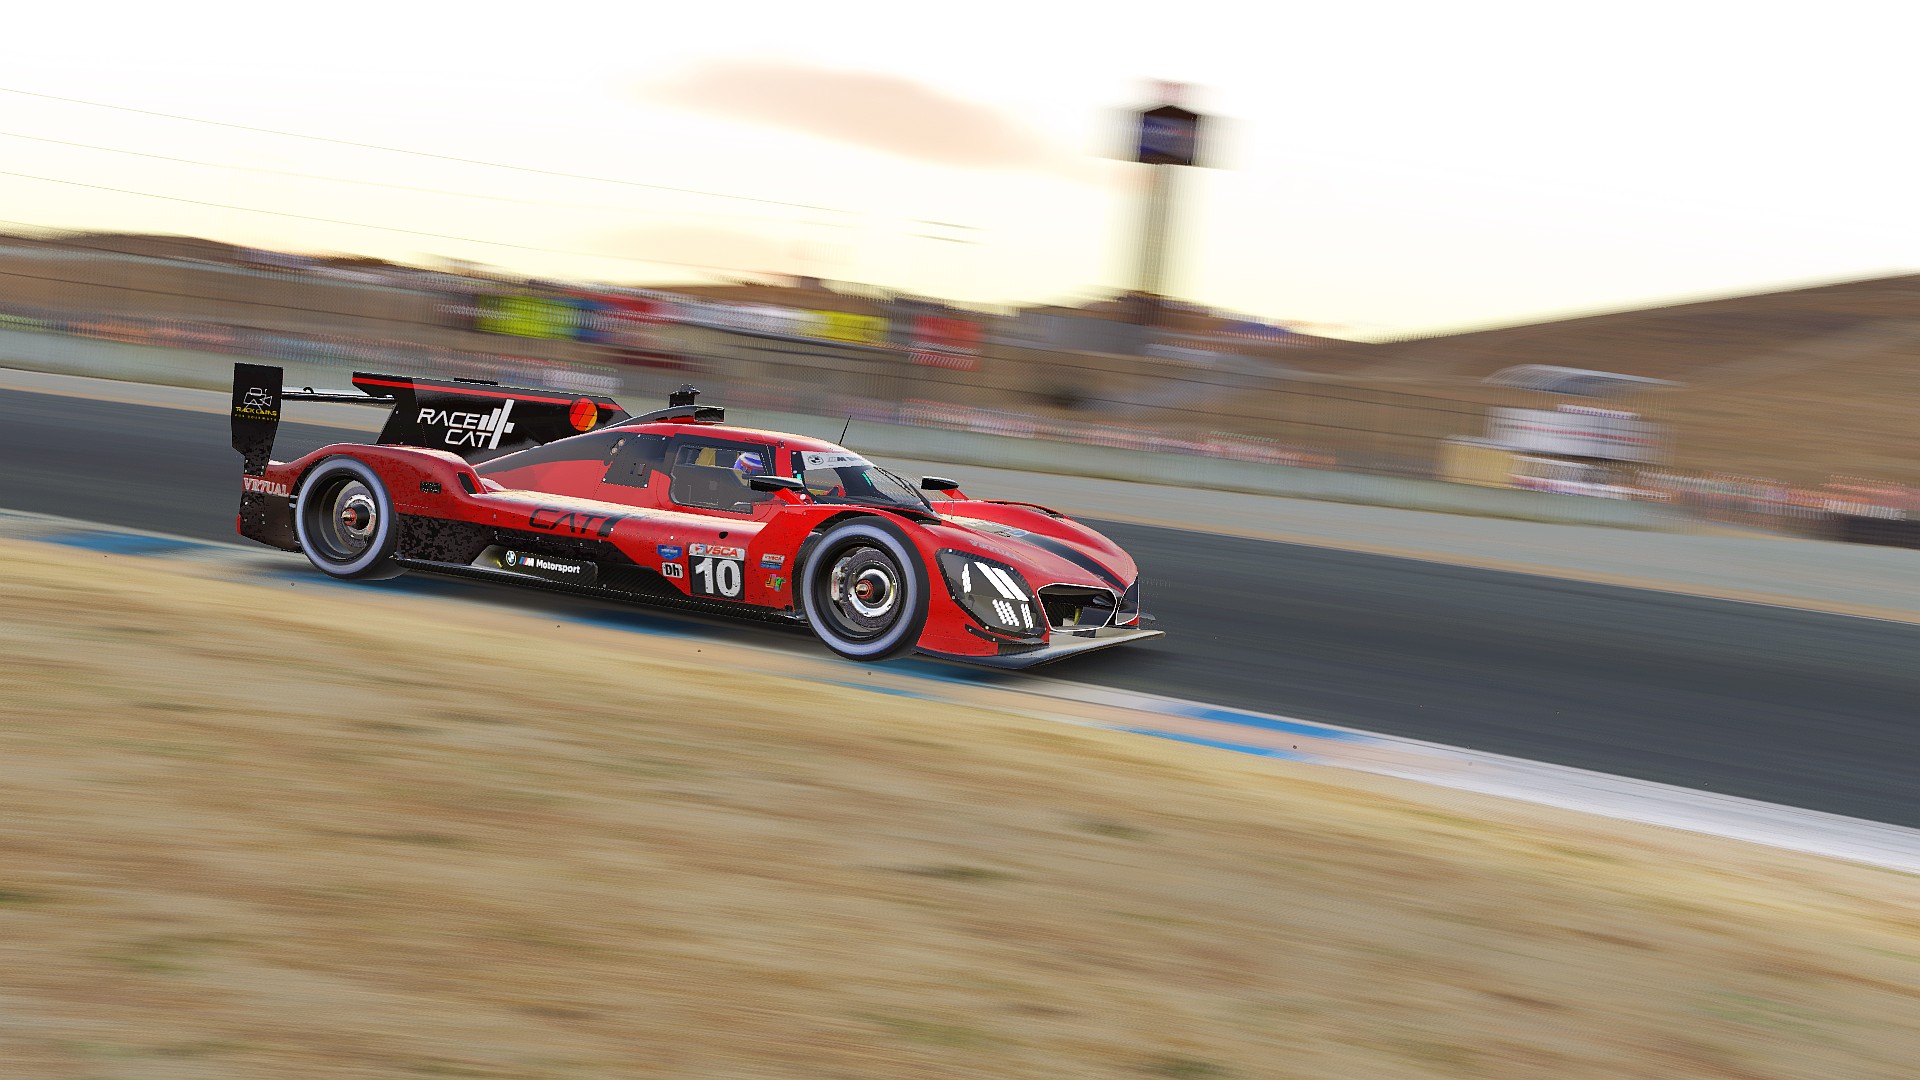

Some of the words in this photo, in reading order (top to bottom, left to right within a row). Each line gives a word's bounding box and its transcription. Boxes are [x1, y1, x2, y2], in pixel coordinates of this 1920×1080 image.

[417, 408, 480, 430] RACE
[444, 428, 492, 448] CAT
[529, 508, 606, 533] CAT
[705, 545, 738, 557] VSCA
[536, 558, 581, 574] Motorsport
[665, 564, 680, 576] Dh
[695, 558, 741, 597] 10
